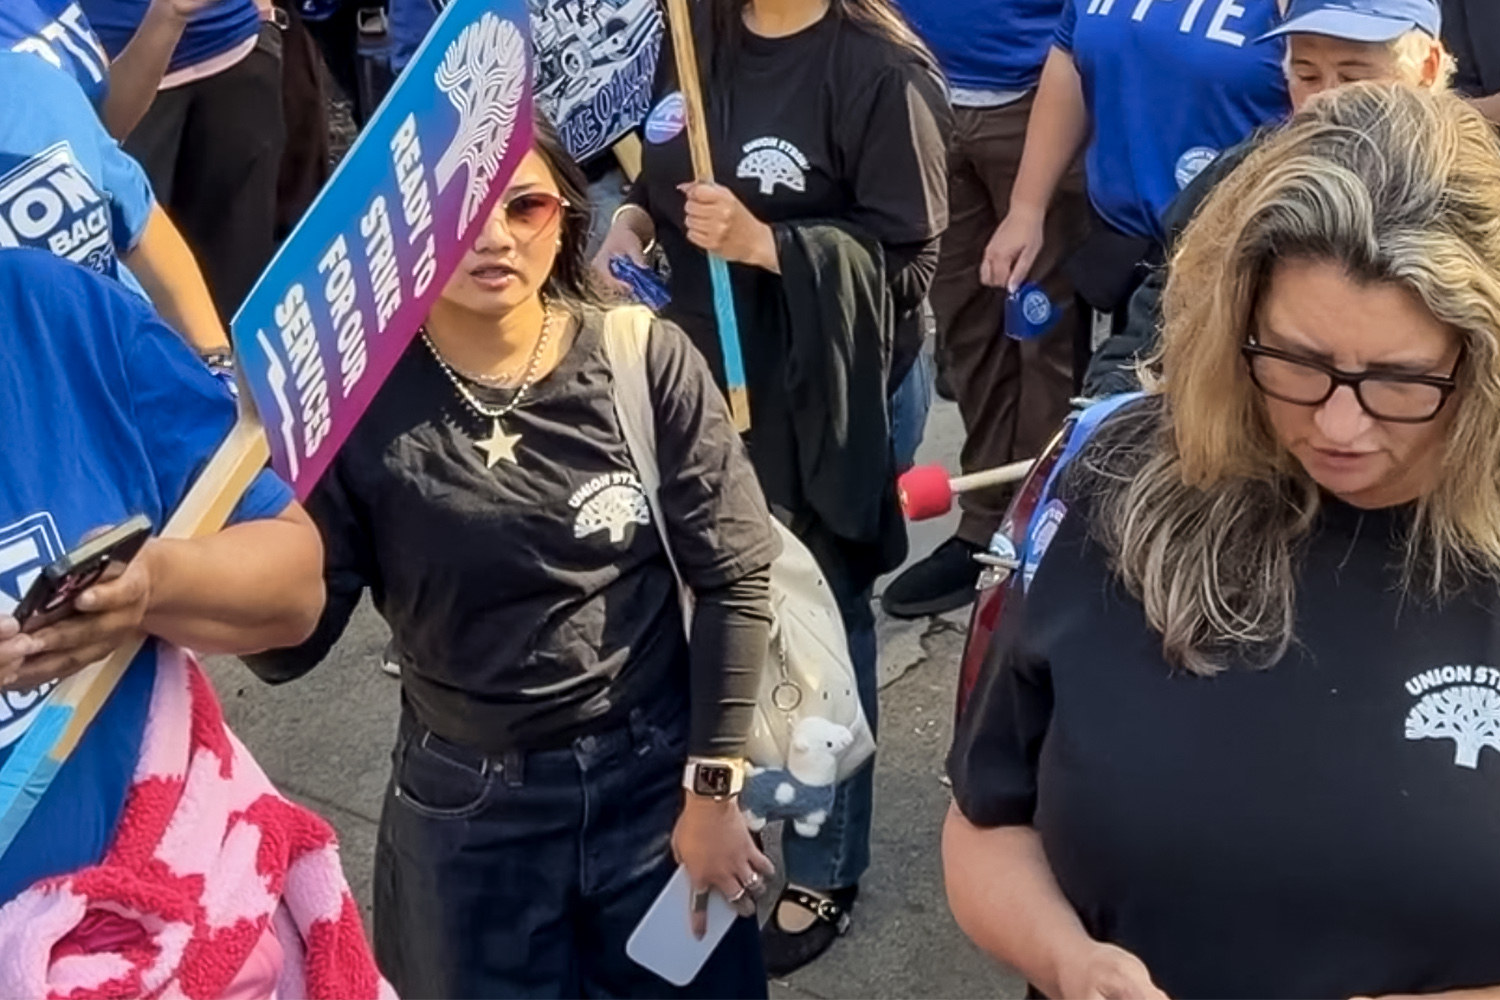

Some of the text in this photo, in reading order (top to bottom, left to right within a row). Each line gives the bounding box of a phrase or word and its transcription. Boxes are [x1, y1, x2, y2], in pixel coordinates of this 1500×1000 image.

[360, 194, 402, 334] STRIKE
[389, 111, 437, 299] READY TO
[274, 282, 332, 459] SERVICES
[317, 233, 368, 399] FOR OUR
[567, 472, 611, 510] UNION
[1404, 665, 1472, 696] UNION
